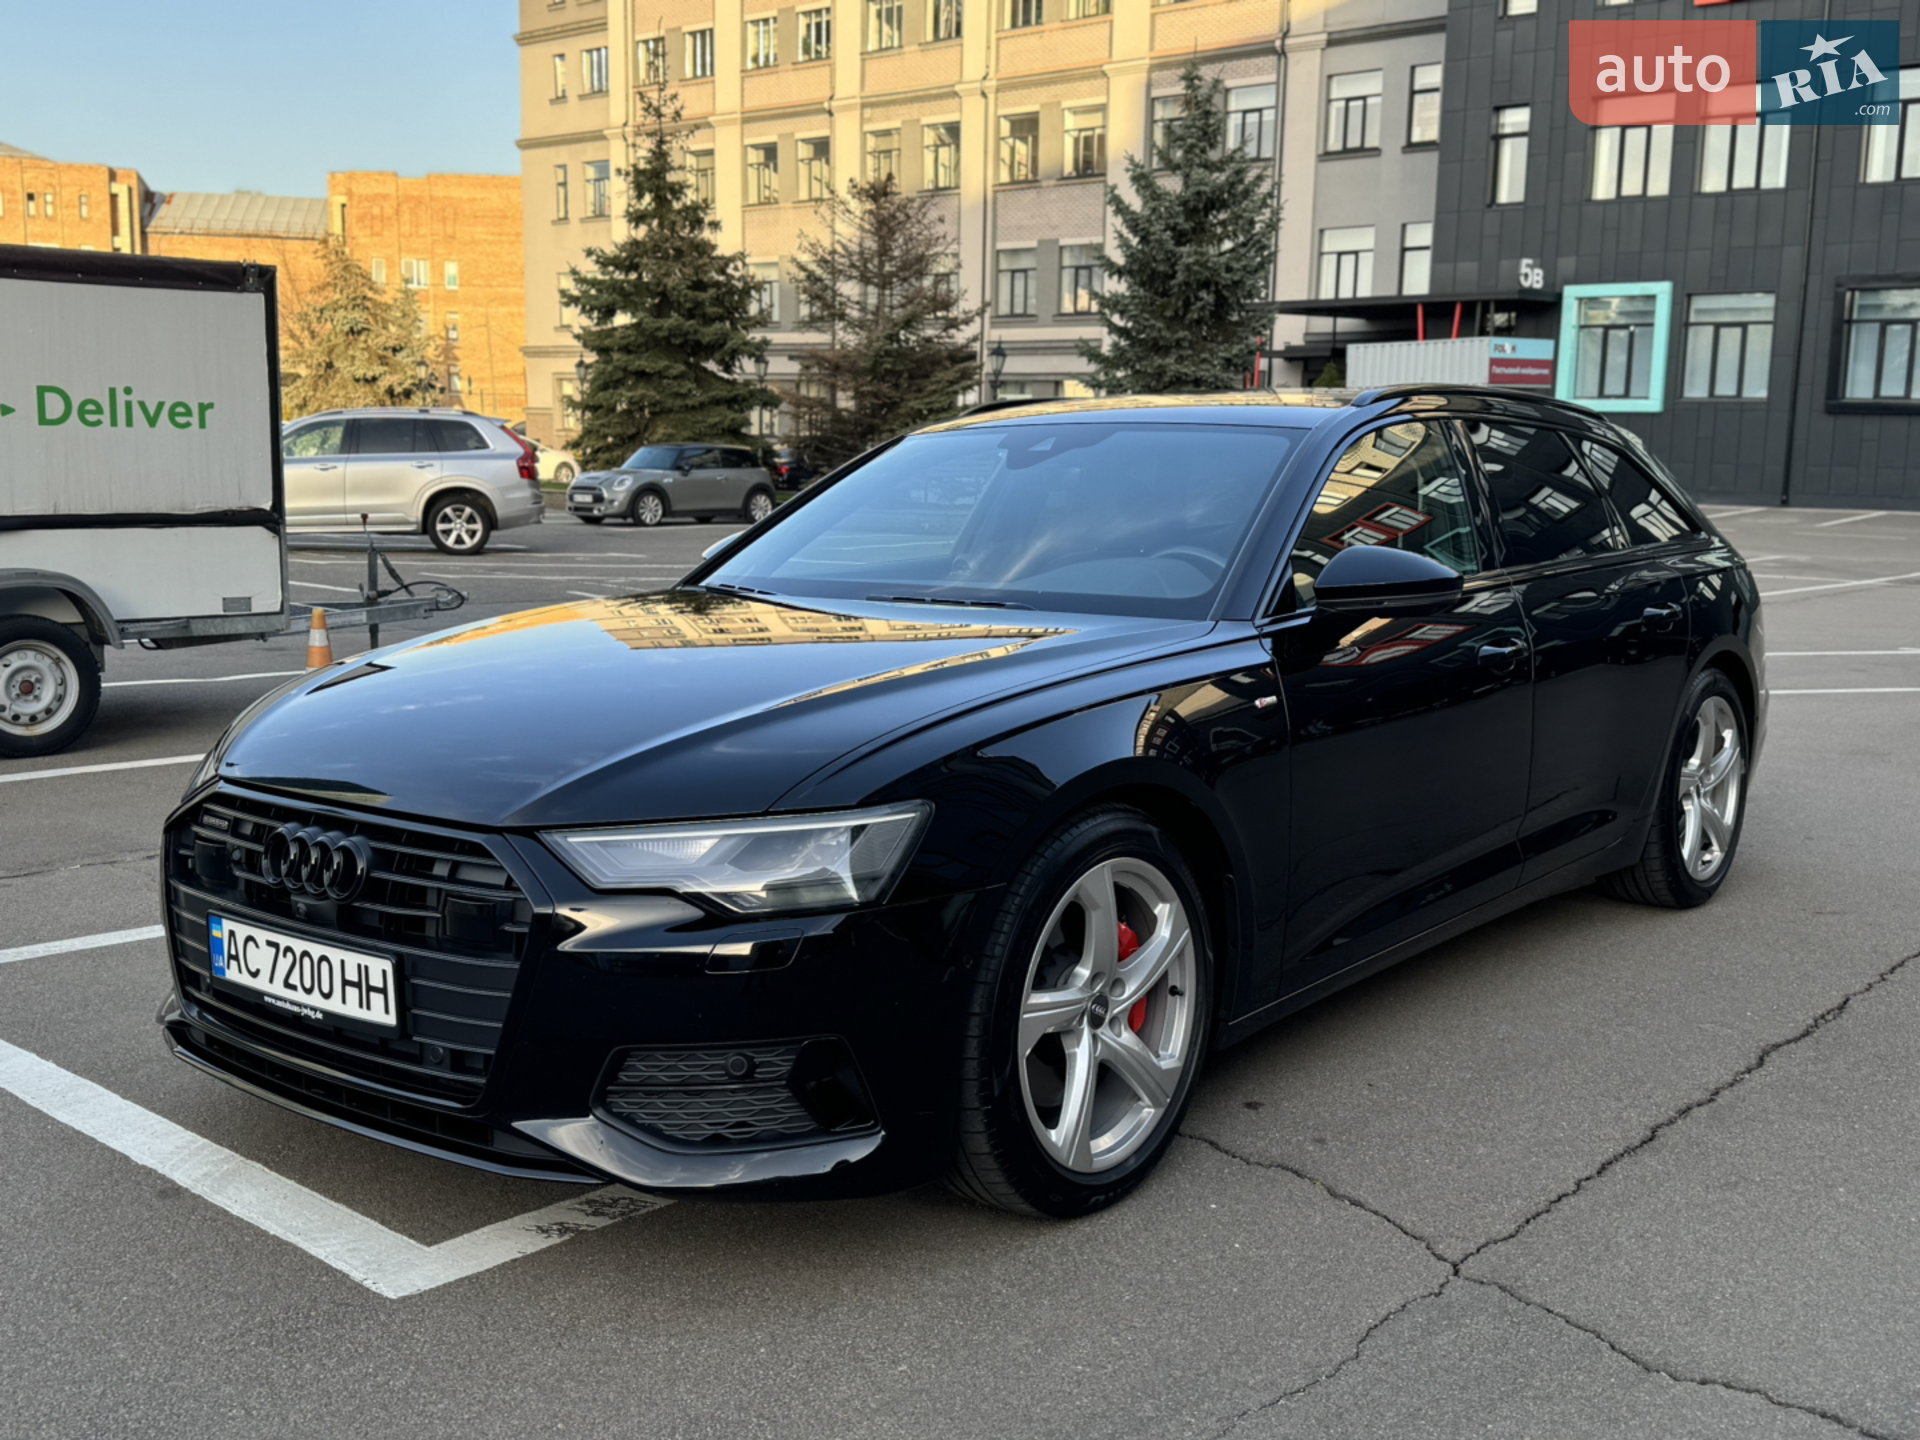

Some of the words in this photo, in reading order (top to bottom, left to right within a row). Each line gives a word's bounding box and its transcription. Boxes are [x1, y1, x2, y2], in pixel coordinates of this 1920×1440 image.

[36, 384, 215, 430] Deliver
[213, 954, 225, 968] UA
[226, 928, 261, 979] AC
[265, 939, 334, 1000] 7200
[340, 958, 390, 1015] HH
